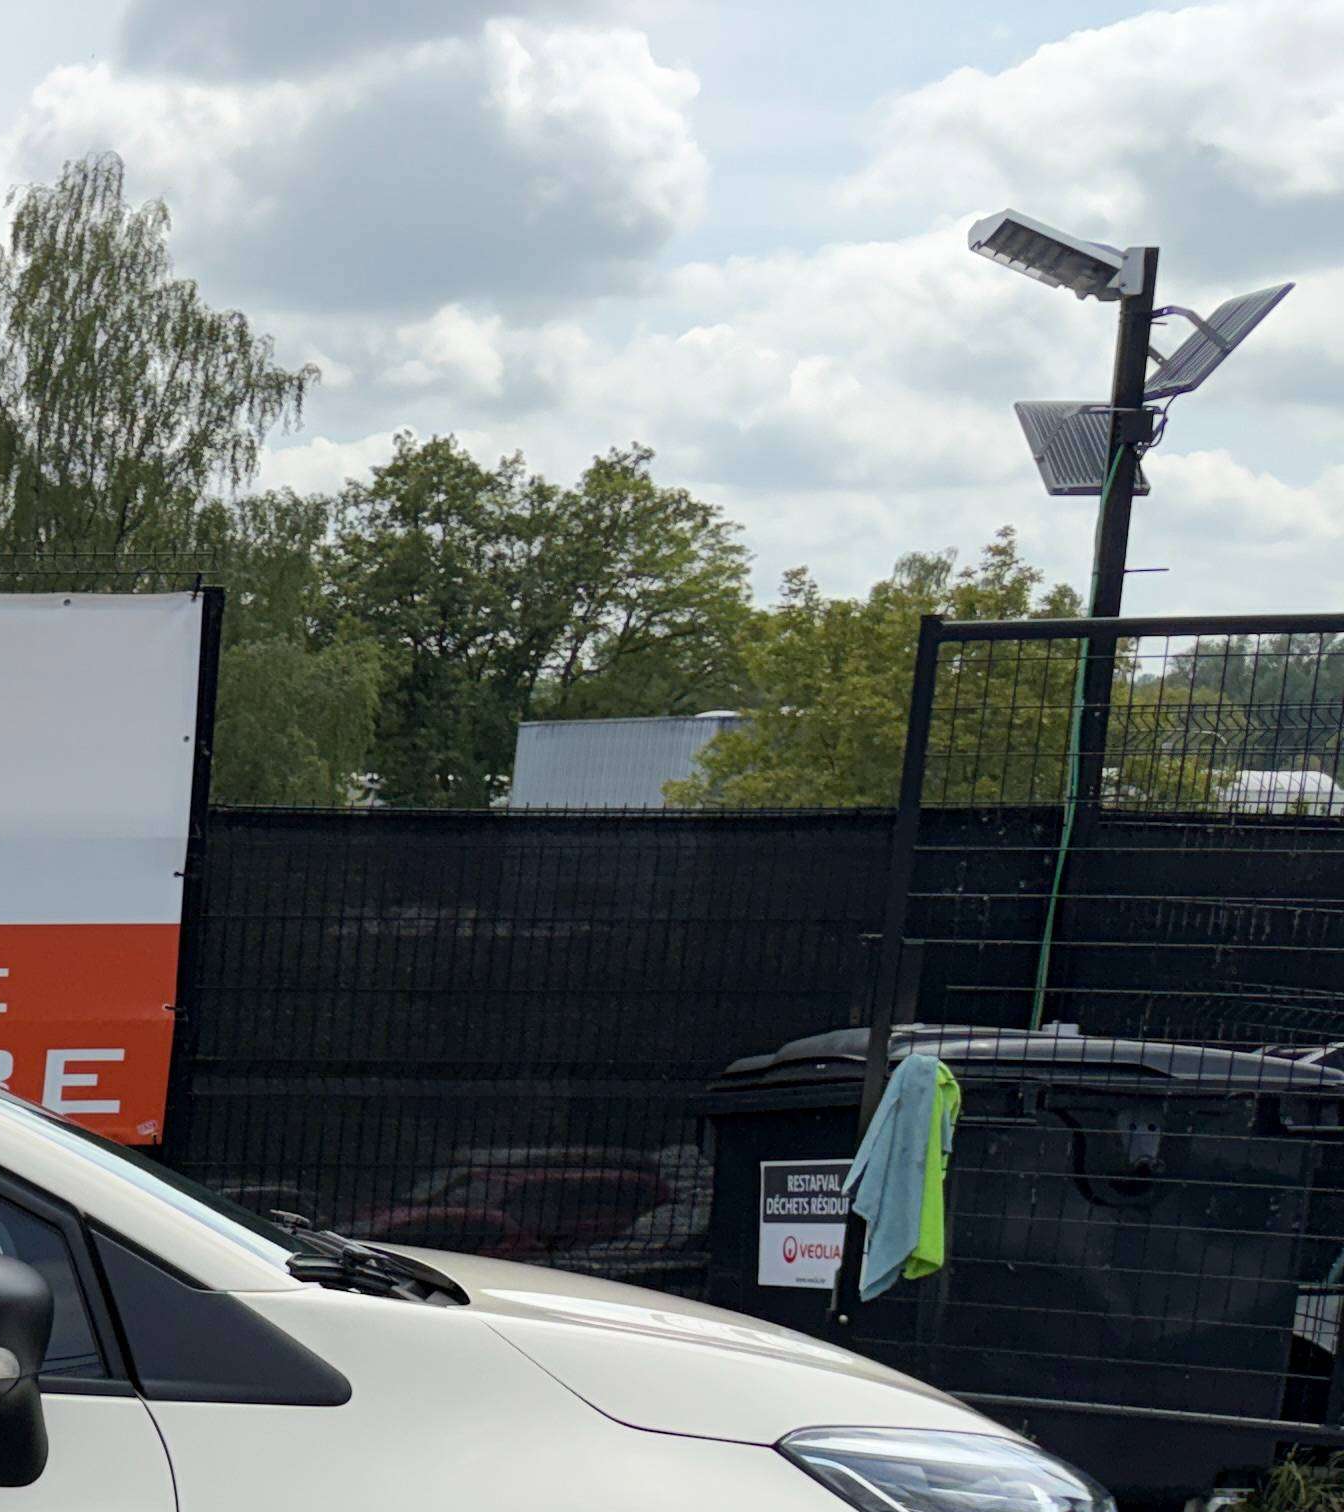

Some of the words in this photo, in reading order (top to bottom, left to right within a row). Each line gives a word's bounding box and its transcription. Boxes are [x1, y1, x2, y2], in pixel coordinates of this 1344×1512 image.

[787, 1174, 840, 1192] RESTAFVAL
[766, 1194, 810, 1215] DÉCHETS
[799, 1243, 842, 1260] VEOLIA
